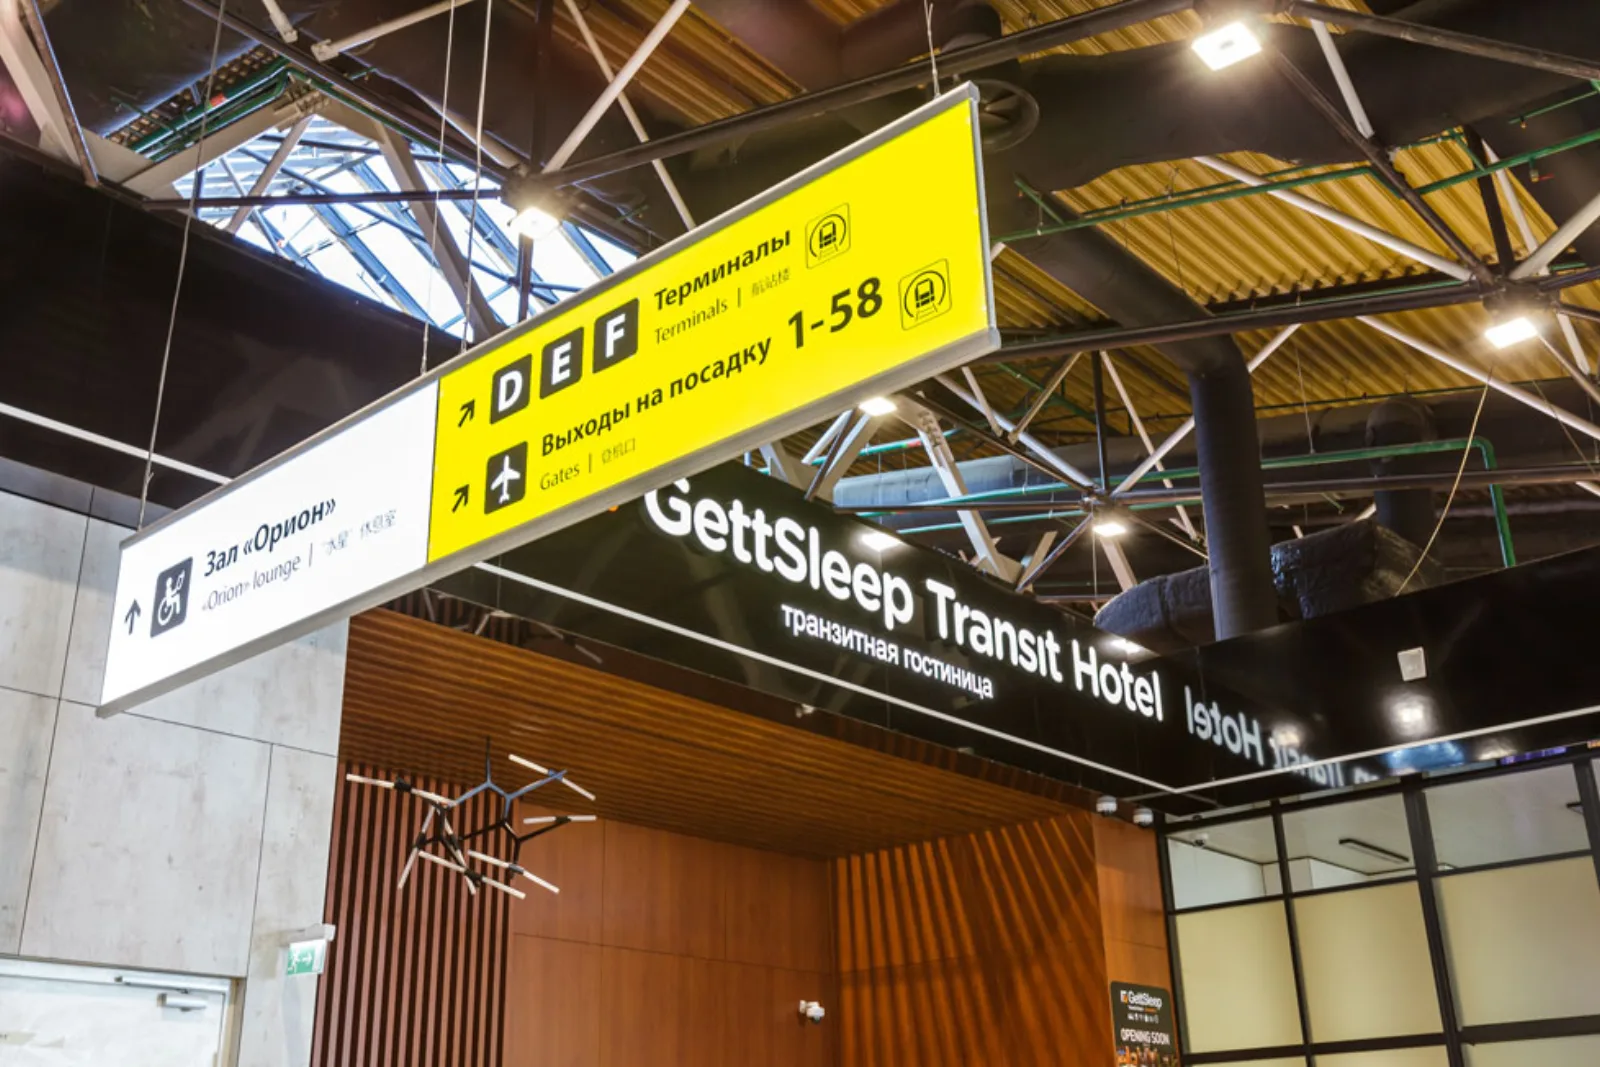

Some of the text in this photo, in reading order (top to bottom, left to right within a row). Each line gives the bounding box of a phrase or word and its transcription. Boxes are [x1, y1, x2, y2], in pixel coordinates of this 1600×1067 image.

[654, 230, 790, 311] Терминалы
[654, 298, 728, 345] Terminals
[498, 313, 626, 412] D E F
[541, 276, 883, 457] Выходы на посадку 1-58
[539, 463, 580, 491] Gates
[204, 498, 336, 577] Зал «Орион»
[202, 556, 301, 611] «Orion» lounge
[645, 478, 1164, 722] GettSleep Transit Hotel
[781, 603, 994, 700] транзитная гостиница
[1120, 1028, 1171, 1046] OPENING SOON
